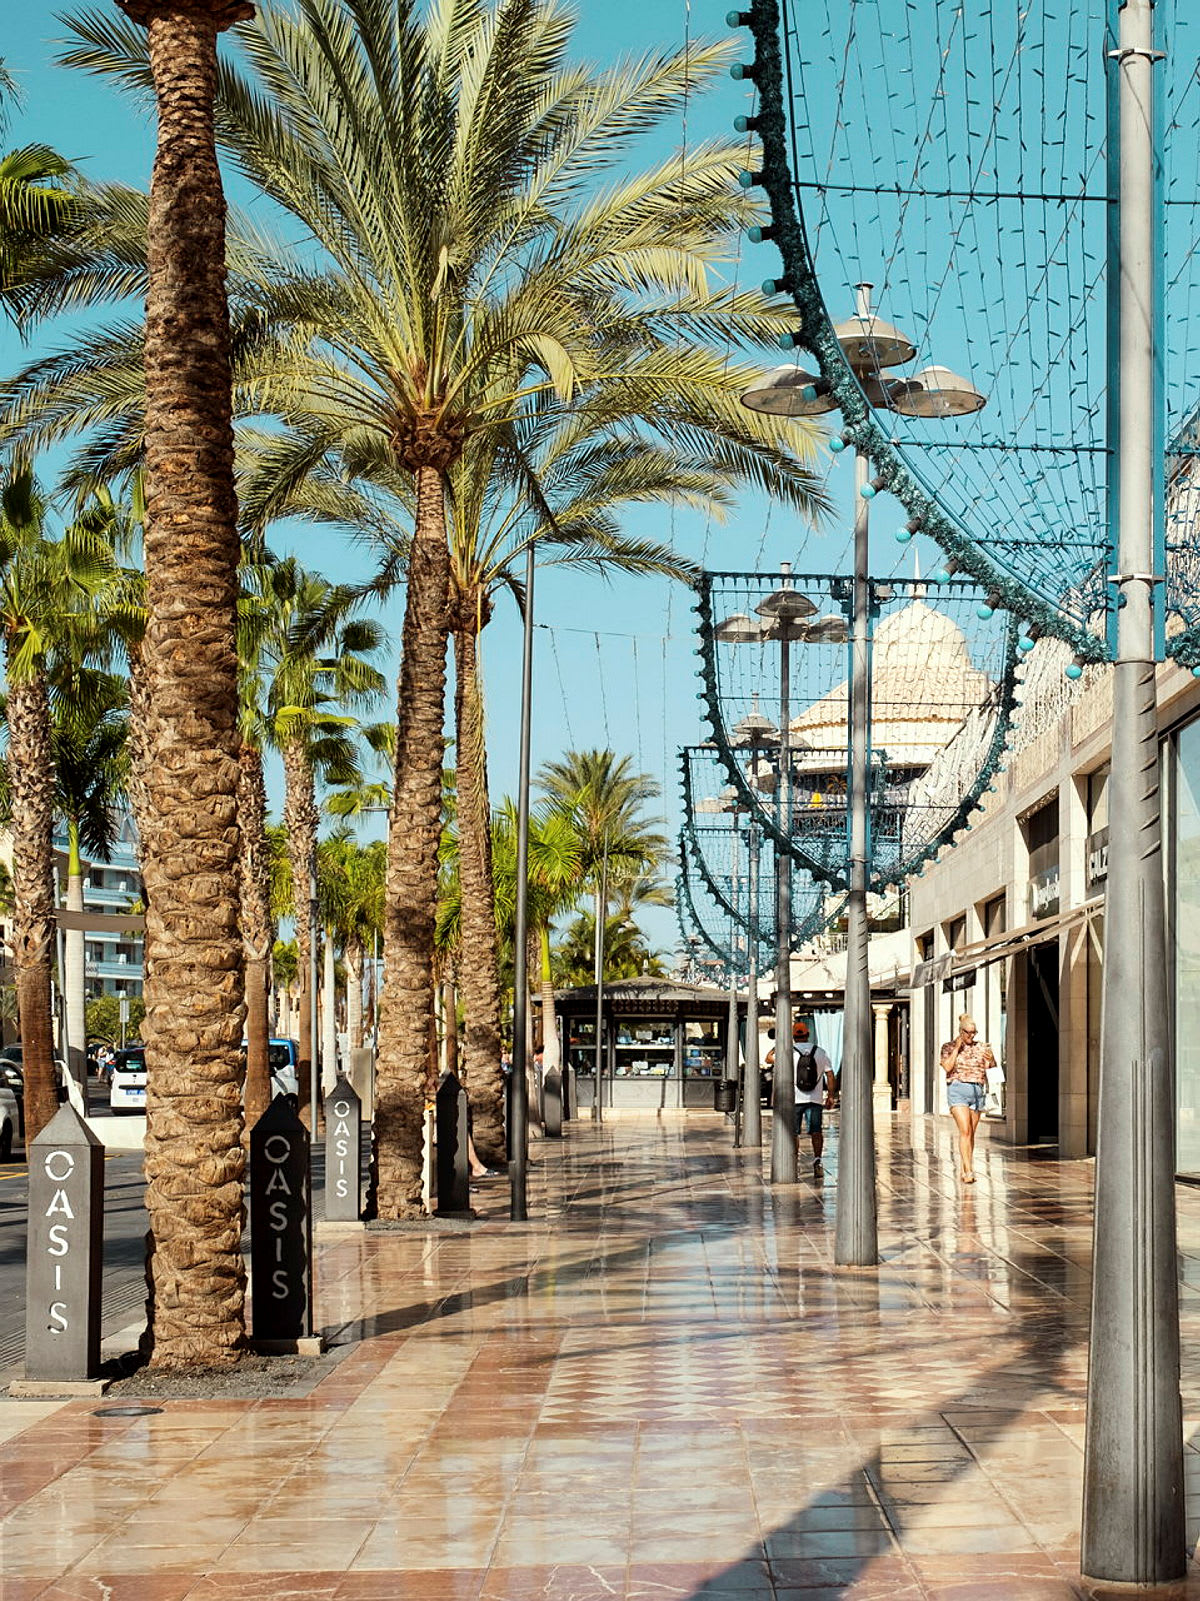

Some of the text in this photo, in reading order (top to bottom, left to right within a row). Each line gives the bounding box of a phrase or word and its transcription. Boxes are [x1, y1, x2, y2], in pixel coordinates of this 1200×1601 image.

[264, 1135, 292, 1300] OASIS
[334, 1101, 351, 1198] OASIS
[45, 1151, 75, 1334] OASIS
